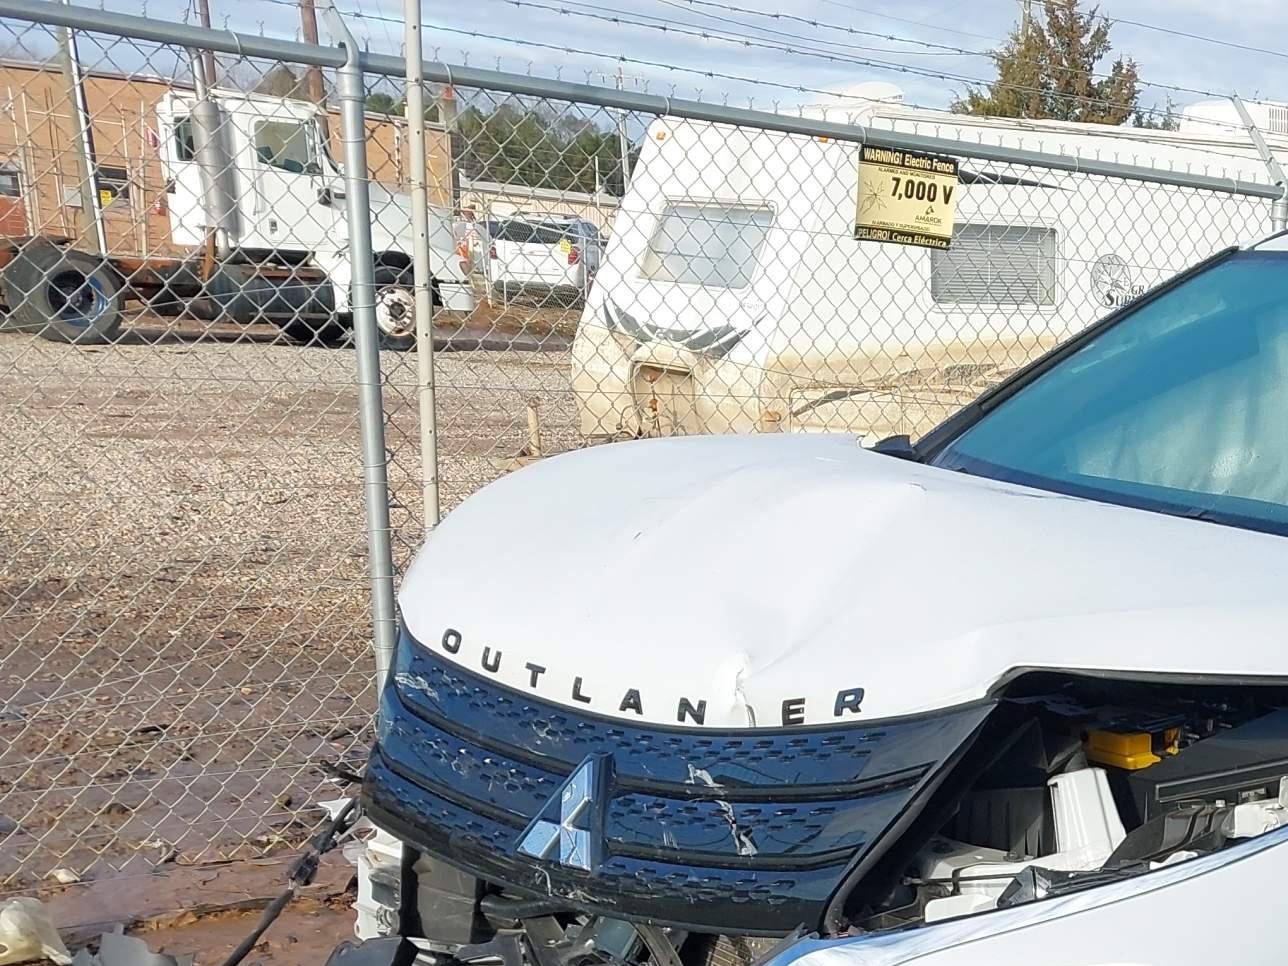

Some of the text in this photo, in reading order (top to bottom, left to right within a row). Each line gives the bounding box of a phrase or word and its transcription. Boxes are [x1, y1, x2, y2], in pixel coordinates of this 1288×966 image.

[864, 148, 955, 173] WARNING! Electric Fence
[891, 176, 954, 205] 7,000 V
[892, 233, 913, 243] Cerca
[914, 235, 948, 248] Eléctrica
